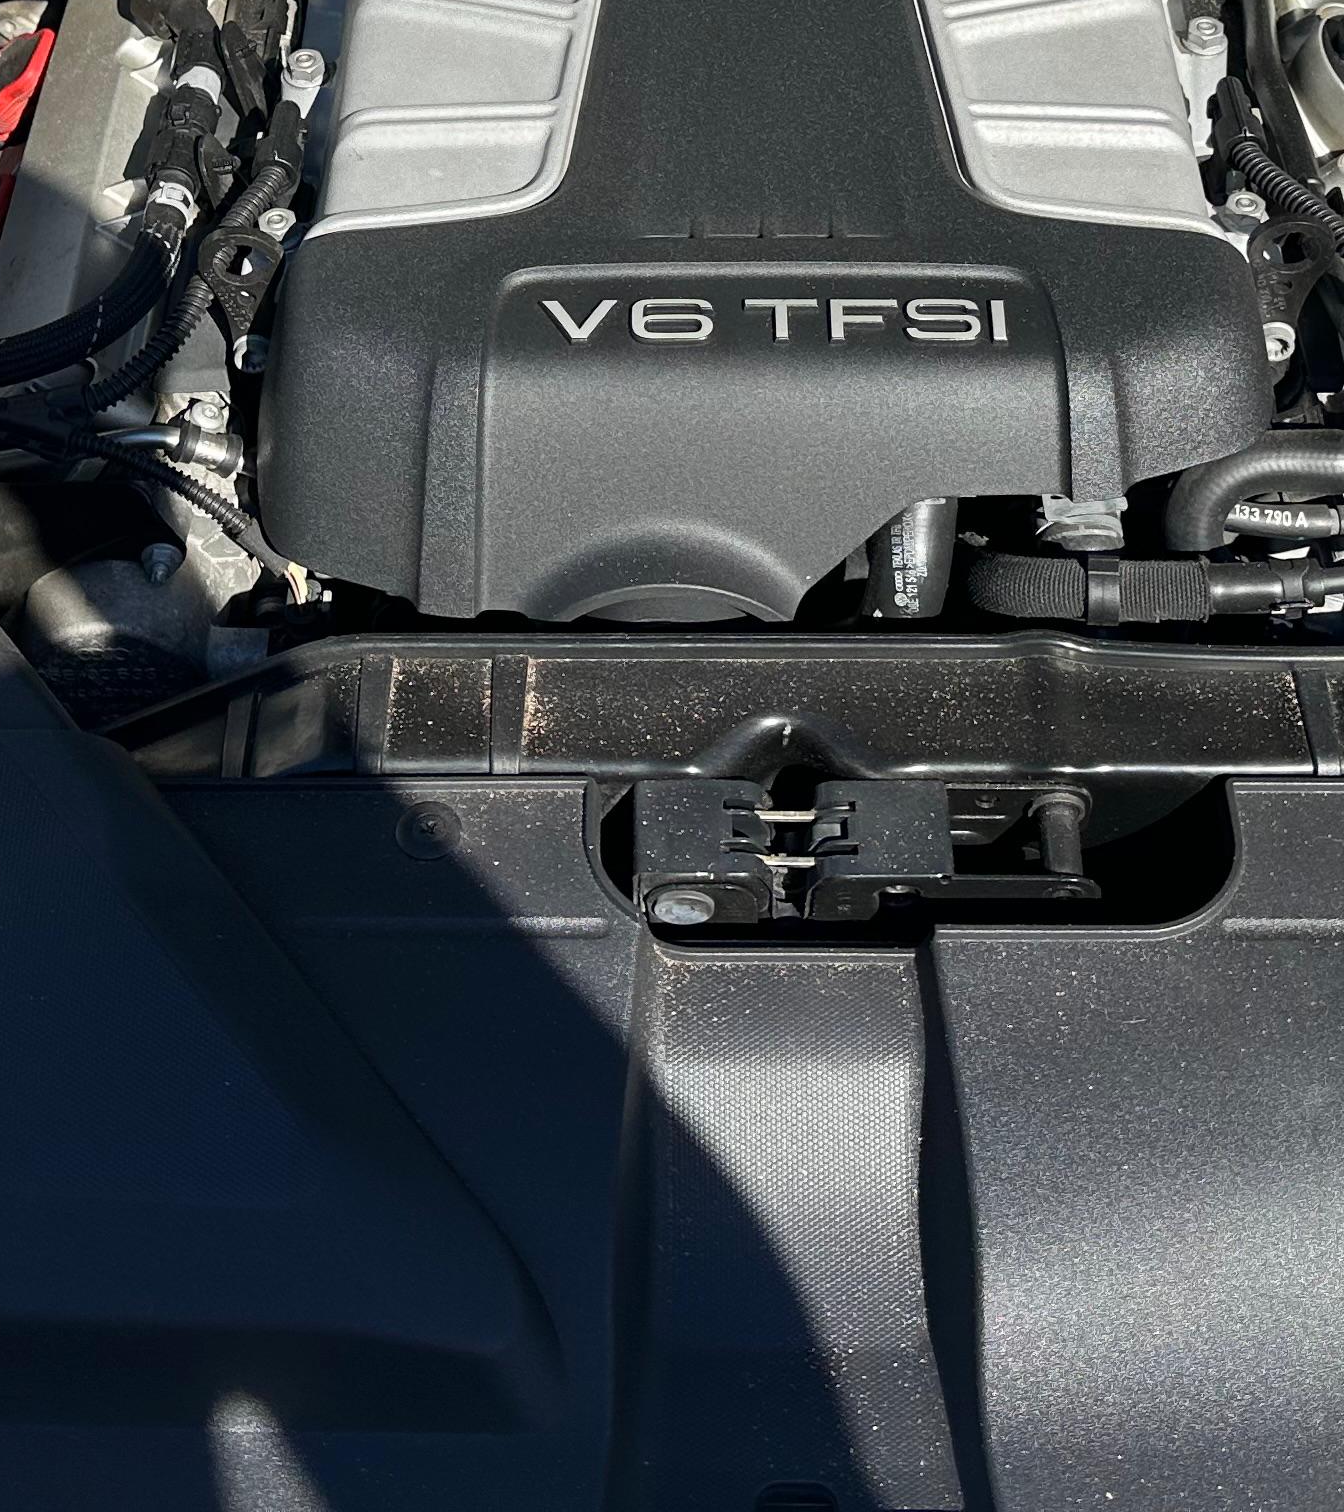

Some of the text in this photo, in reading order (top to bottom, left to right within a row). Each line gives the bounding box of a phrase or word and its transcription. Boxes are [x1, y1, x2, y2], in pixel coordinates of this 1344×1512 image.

[538, 296, 1010, 344] V6 TFSI
[1264, 509, 1292, 527] 790
[1294, 511, 1309, 528] A
